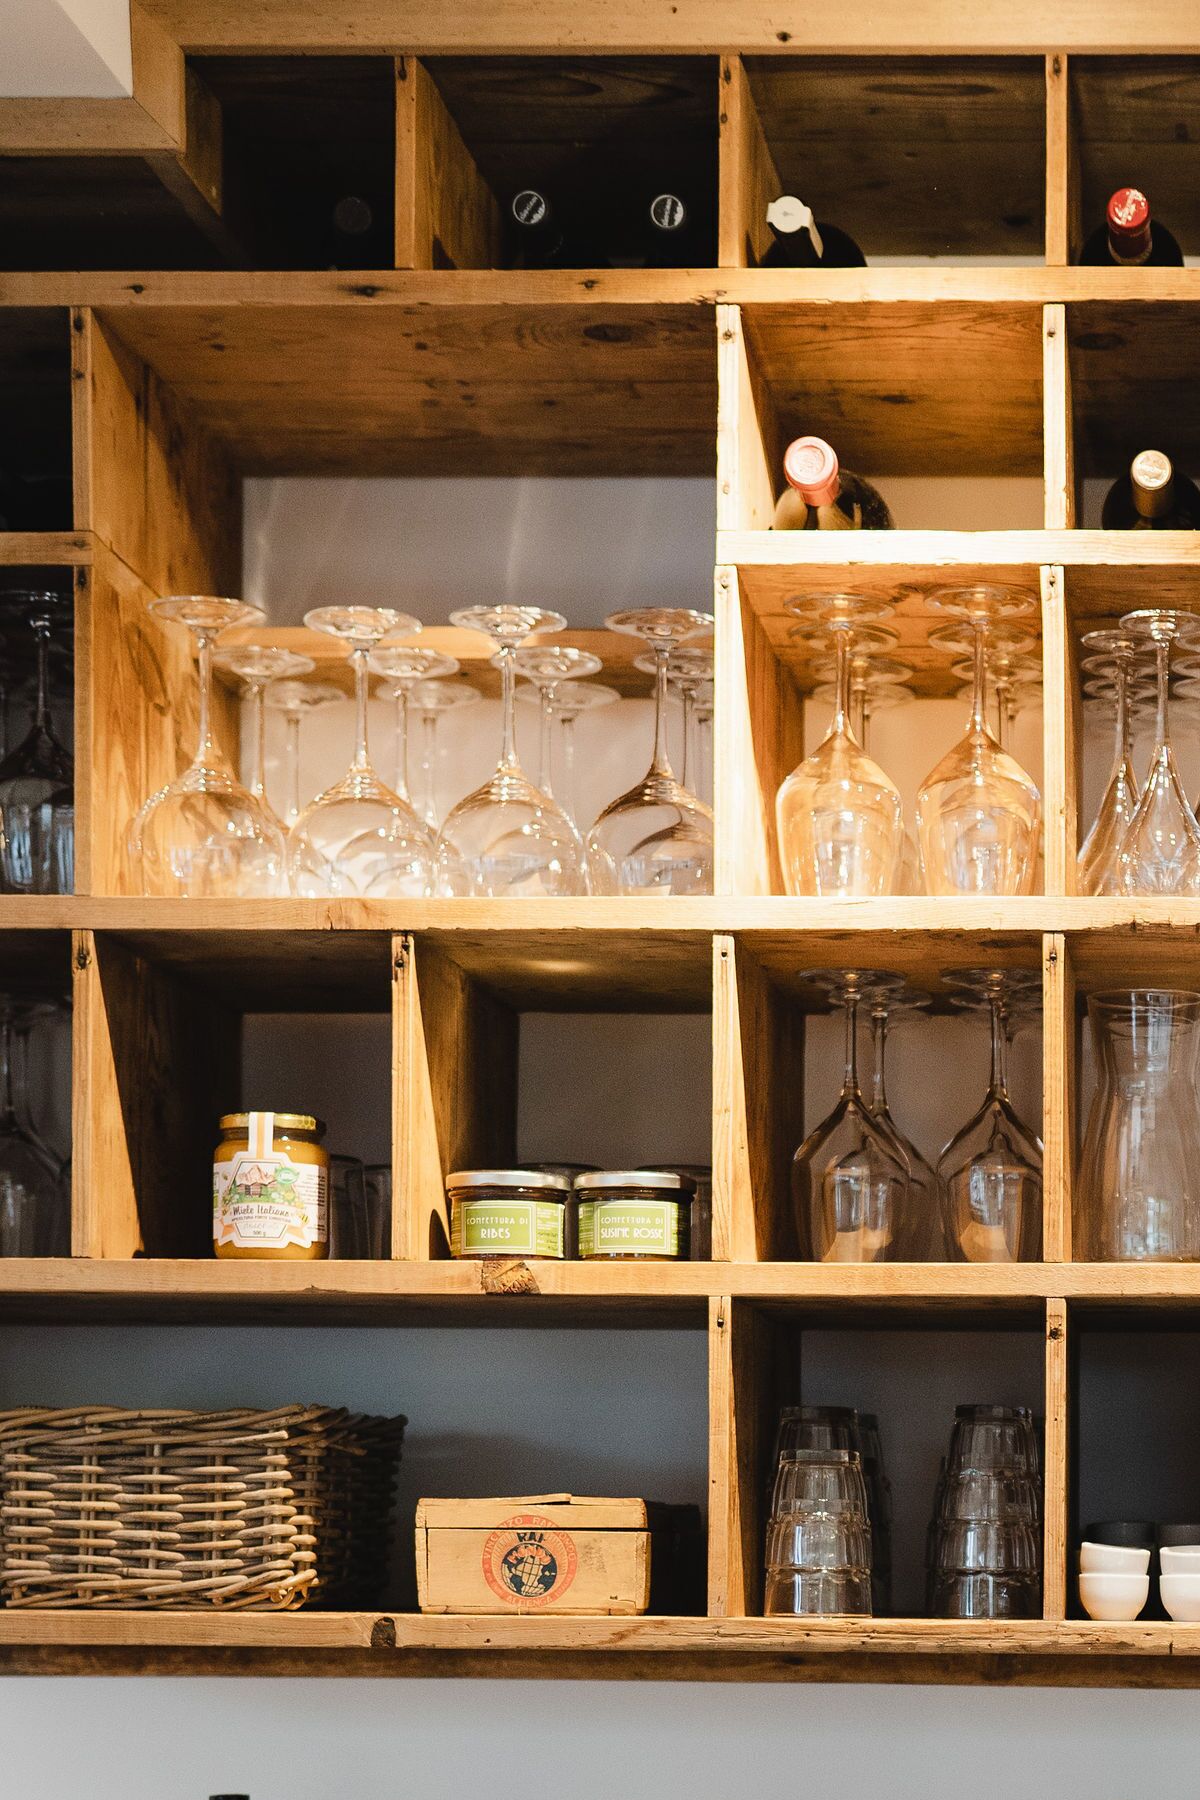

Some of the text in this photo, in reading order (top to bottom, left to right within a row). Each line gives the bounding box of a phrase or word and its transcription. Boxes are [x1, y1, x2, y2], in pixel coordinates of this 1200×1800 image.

[233, 1204, 289, 1216] Miele Italiano
[467, 1216, 529, 1225] CONFETTURA DI
[601, 1216, 664, 1225] CONFETTURA DI
[480, 1227, 511, 1239] RIBES
[601, 1227, 664, 1240] SUSINE ROSSE
